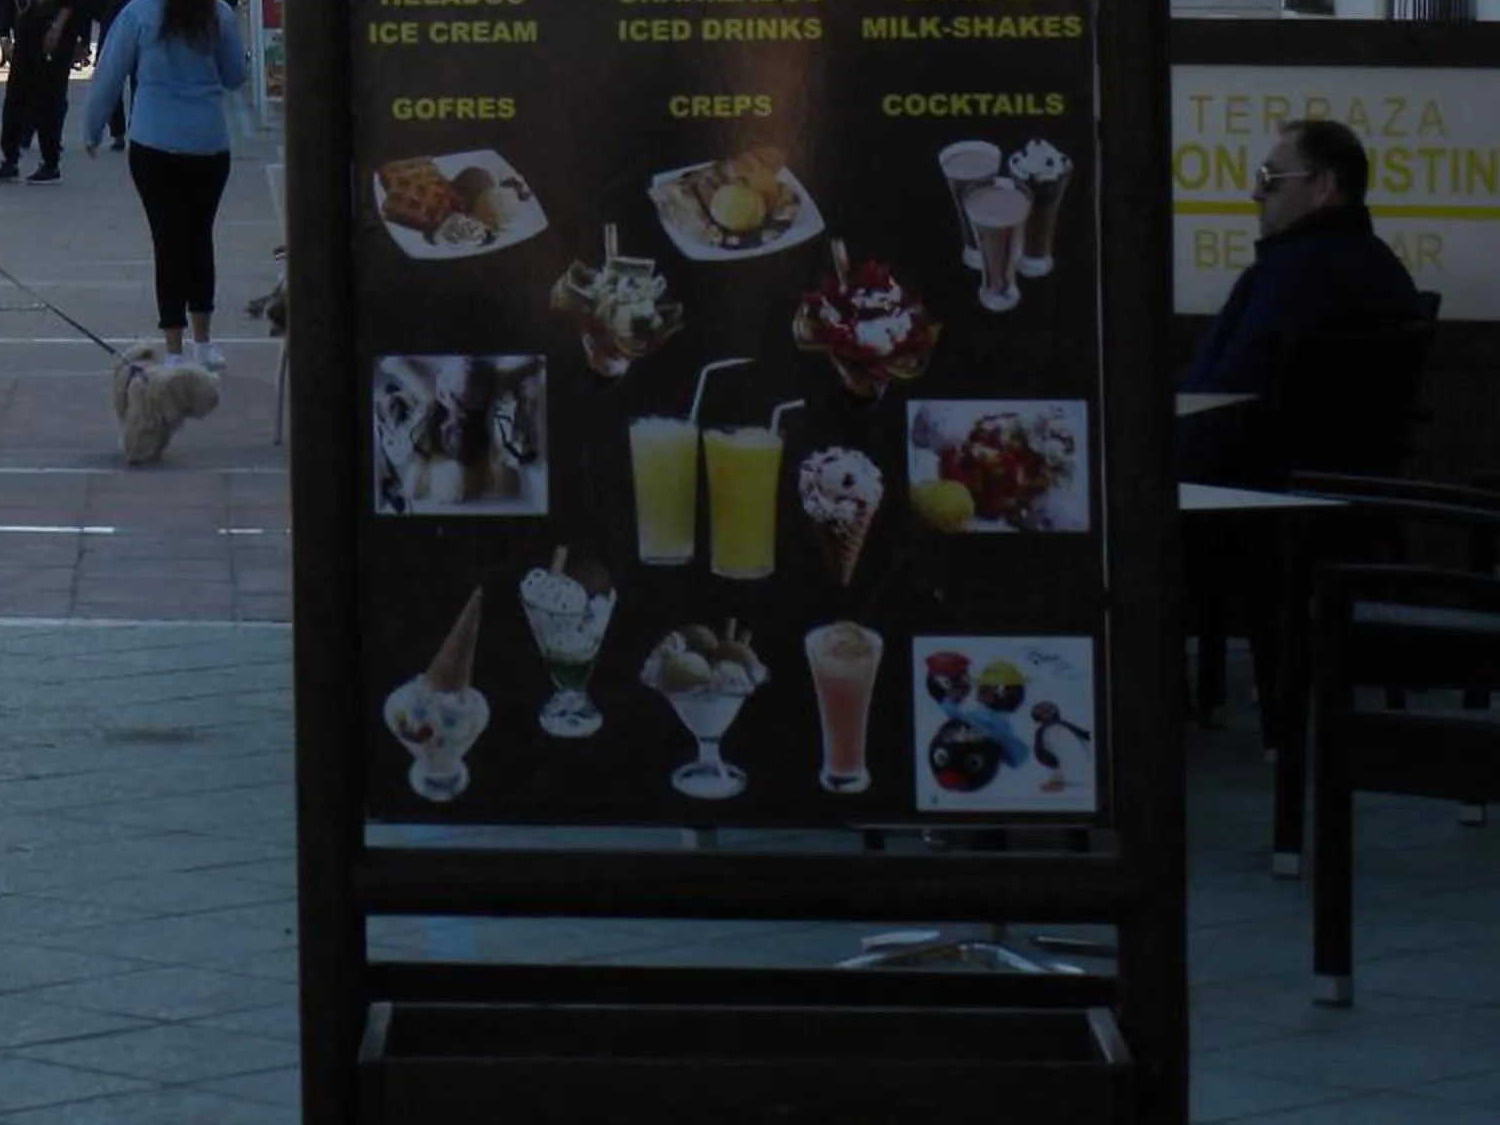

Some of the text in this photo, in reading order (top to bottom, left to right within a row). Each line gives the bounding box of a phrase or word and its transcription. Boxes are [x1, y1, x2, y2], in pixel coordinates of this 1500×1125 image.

[369, 19, 538, 44] ICE CREAM
[618, 17, 823, 42] ICED DRINKS
[861, 14, 1083, 39] MILK-SHAKES
[392, 96, 517, 120] GOFRES
[668, 94, 773, 118] CREPS
[881, 92, 1066, 117] COCKTAILS
[1172, 141, 1498, 195] ON STIN
